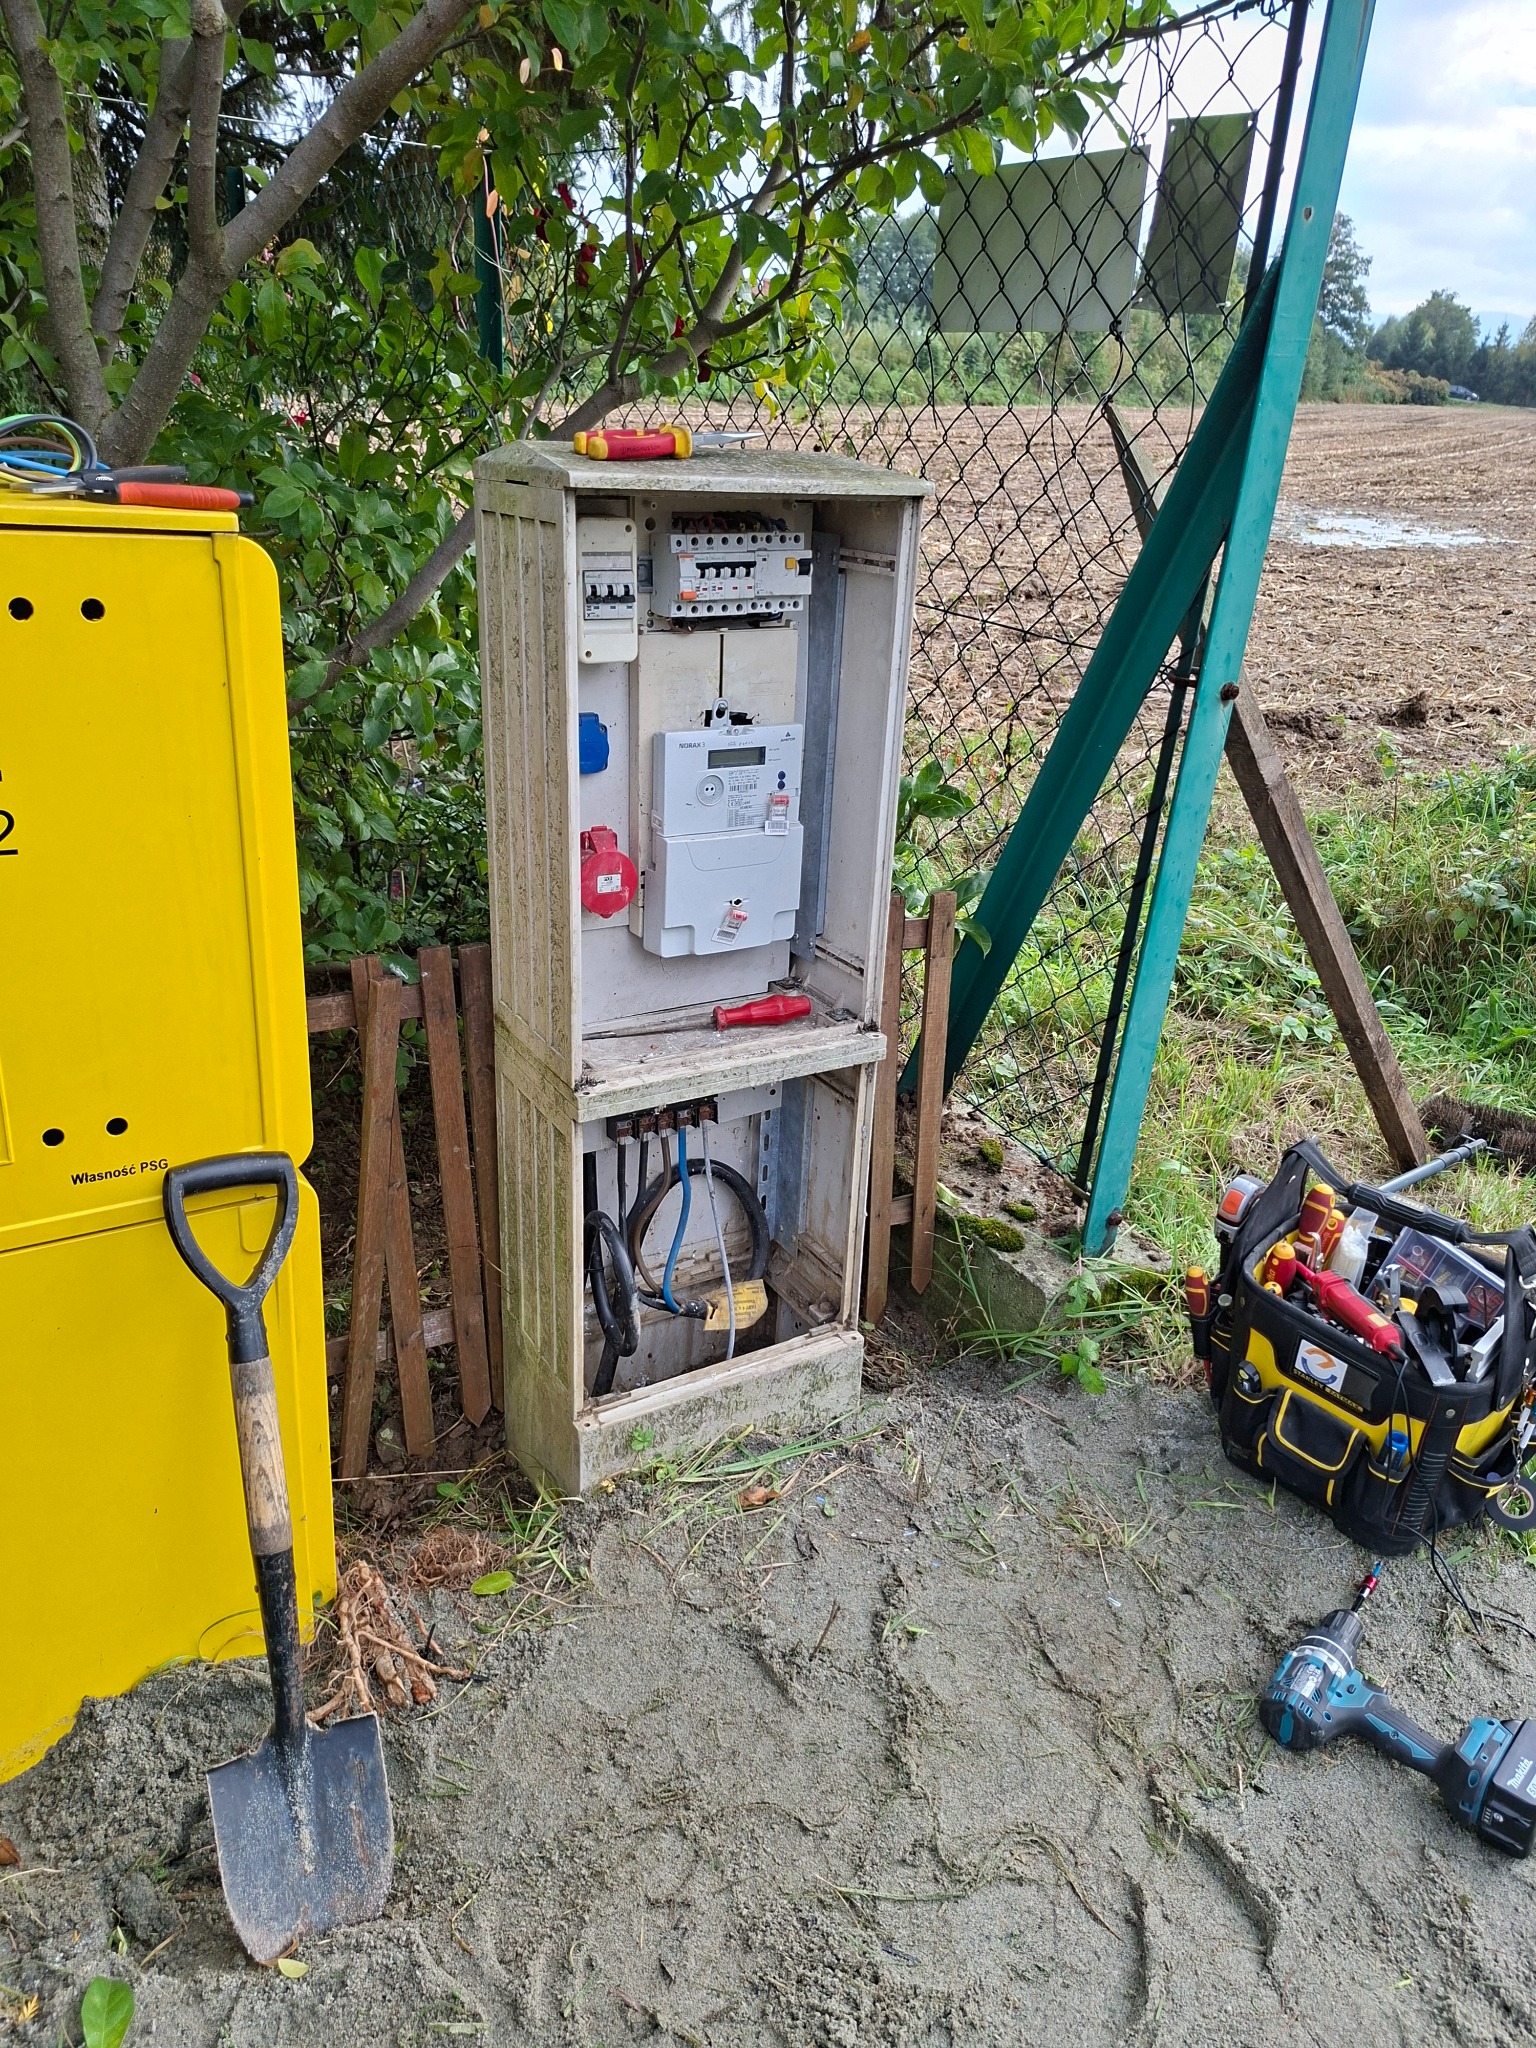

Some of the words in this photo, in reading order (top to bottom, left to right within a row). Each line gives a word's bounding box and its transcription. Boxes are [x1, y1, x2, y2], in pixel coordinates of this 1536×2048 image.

[71, 1164, 137, 1186] Własność
[140, 1158, 169, 1174] PSG
[1292, 1368, 1325, 1389] STANLEY
[1507, 1756, 1534, 1789] Makita
